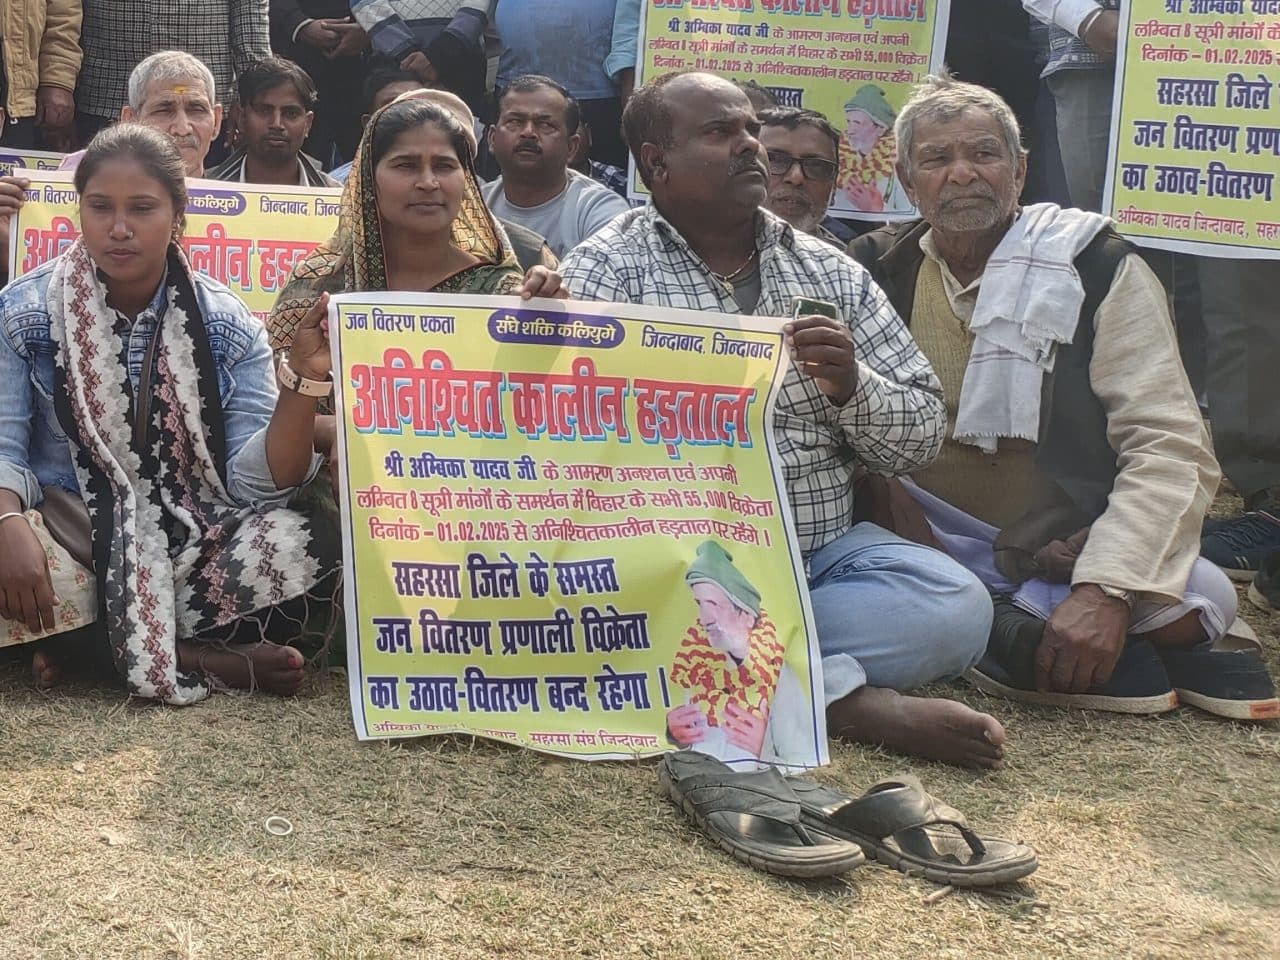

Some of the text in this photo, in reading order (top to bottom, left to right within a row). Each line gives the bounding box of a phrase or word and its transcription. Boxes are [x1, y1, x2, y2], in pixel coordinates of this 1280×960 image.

[1135, 20, 1265, 44] लम्बित 8 सूत्री मांगों
[1142, 44, 1273, 65] दिनांक 01.02.2025
[1157, 73, 1273, 109] सहरसा जिले
[1133, 115, 1240, 153] जन वितरण
[1121, 162, 1274, 201] का उठाव-वितरण
[1118, 205, 1160, 226] अम्बिका
[1161, 214, 1192, 229] यादव
[344, 308, 455, 334] जन वितरण एकता
[522, 318, 556, 336] शक्ति
[558, 321, 616, 344] कलियुगे
[711, 332, 775, 360] जिन्दाबाद
[350, 347, 756, 460] अनिश्चित कालीन हड़ताल
[385, 450, 738, 485] श्री अम्बिका यादव जी के आमरण अनशन एवं अपनी
[368, 517, 759, 545] दिनांक 01.02.2025 से अनिश्चितकालीन हड़ताल पर रहेंगे
[392, 552, 619, 598] सहरसा जिले के समस्त
[372, 605, 650, 655] जन वितरण प्रणाली विक्रेता
[367, 664, 651, 712] का उठाव-वितरण बन्द रहेगा
